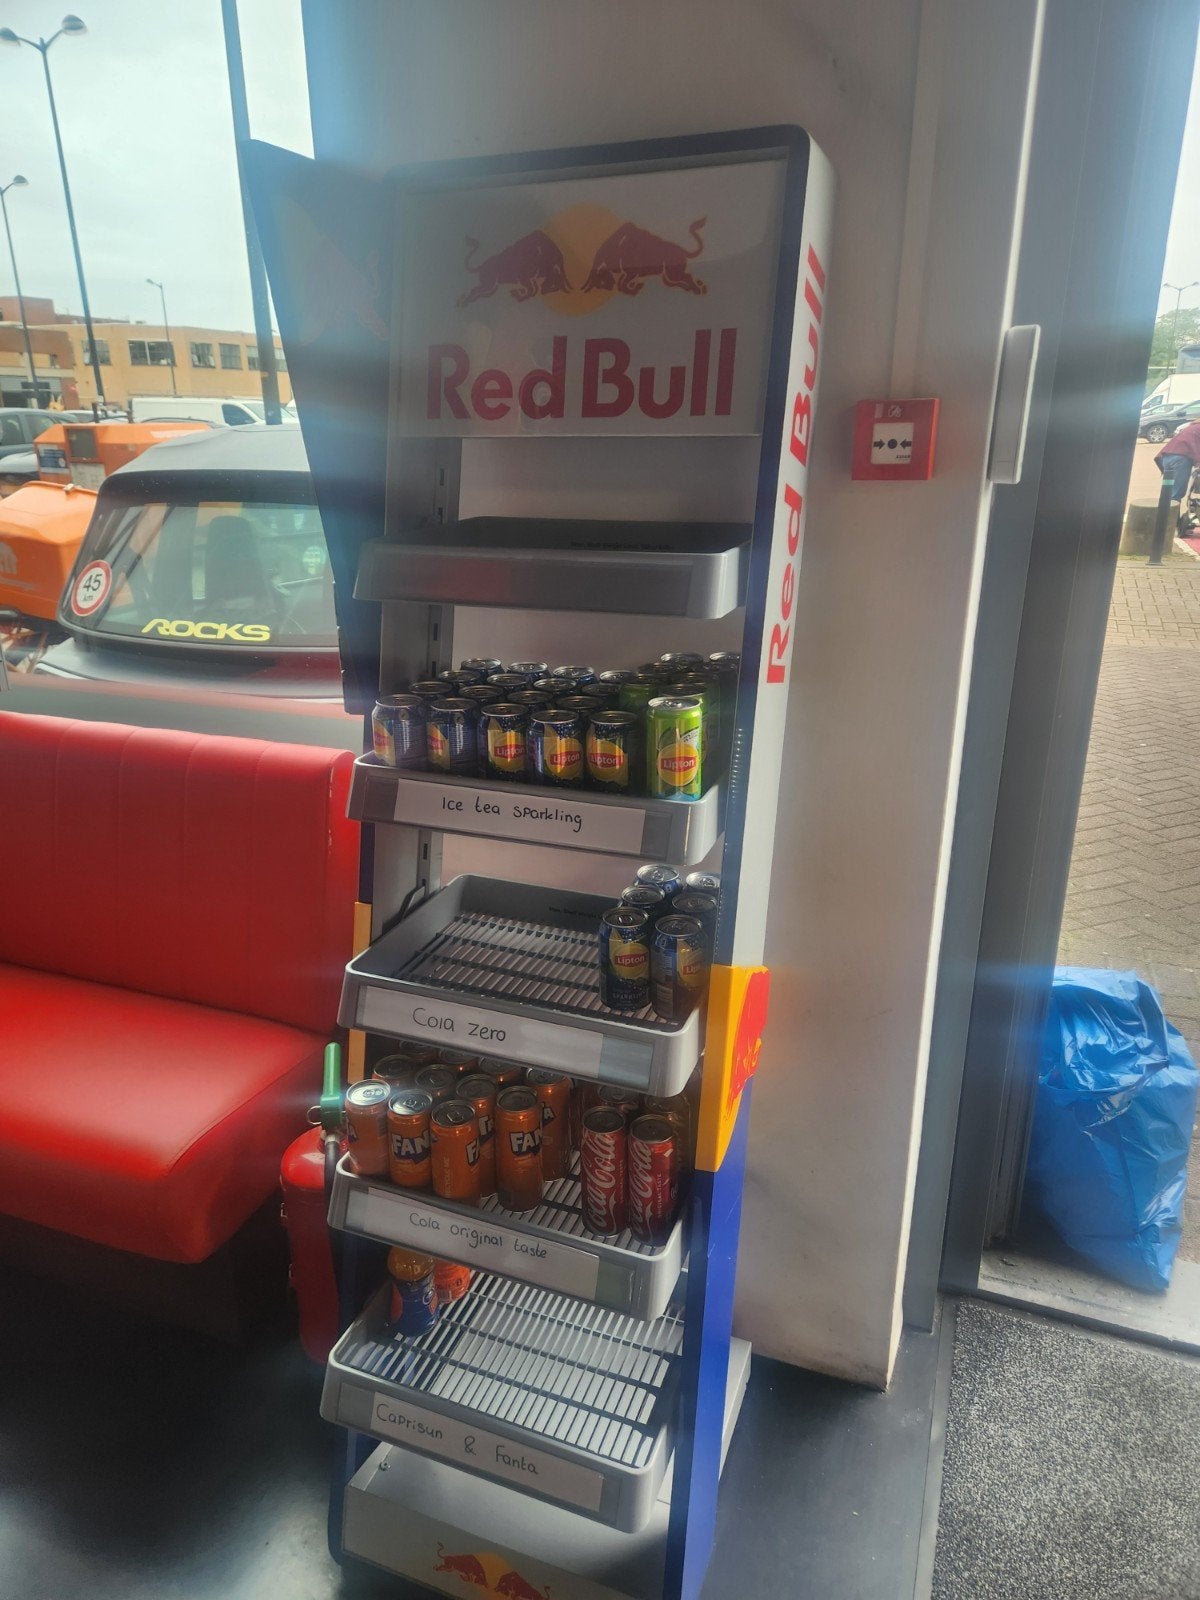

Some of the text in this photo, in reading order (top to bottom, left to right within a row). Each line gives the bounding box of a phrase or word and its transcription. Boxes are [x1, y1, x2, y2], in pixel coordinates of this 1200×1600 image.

[427, 328, 738, 421] Red Bull
[766, 243, 827, 684] Red Bull
[83, 573, 103, 592] 45
[141, 618, 271, 641] ROCKS
[553, 752, 580, 766] Lipton
[663, 758, 695, 770] Lipton
[442, 796, 463, 811] Ice
[474, 796, 501, 815] tea
[617, 956, 646, 967] Lipton
[468, 1022, 506, 1041] zero
[392, 1131, 430, 1157] FAN
[409, 1212, 547, 1259] Cola original taste
[376, 1403, 443, 1440] Caprisun
[464, 1435, 476, 1456] &
